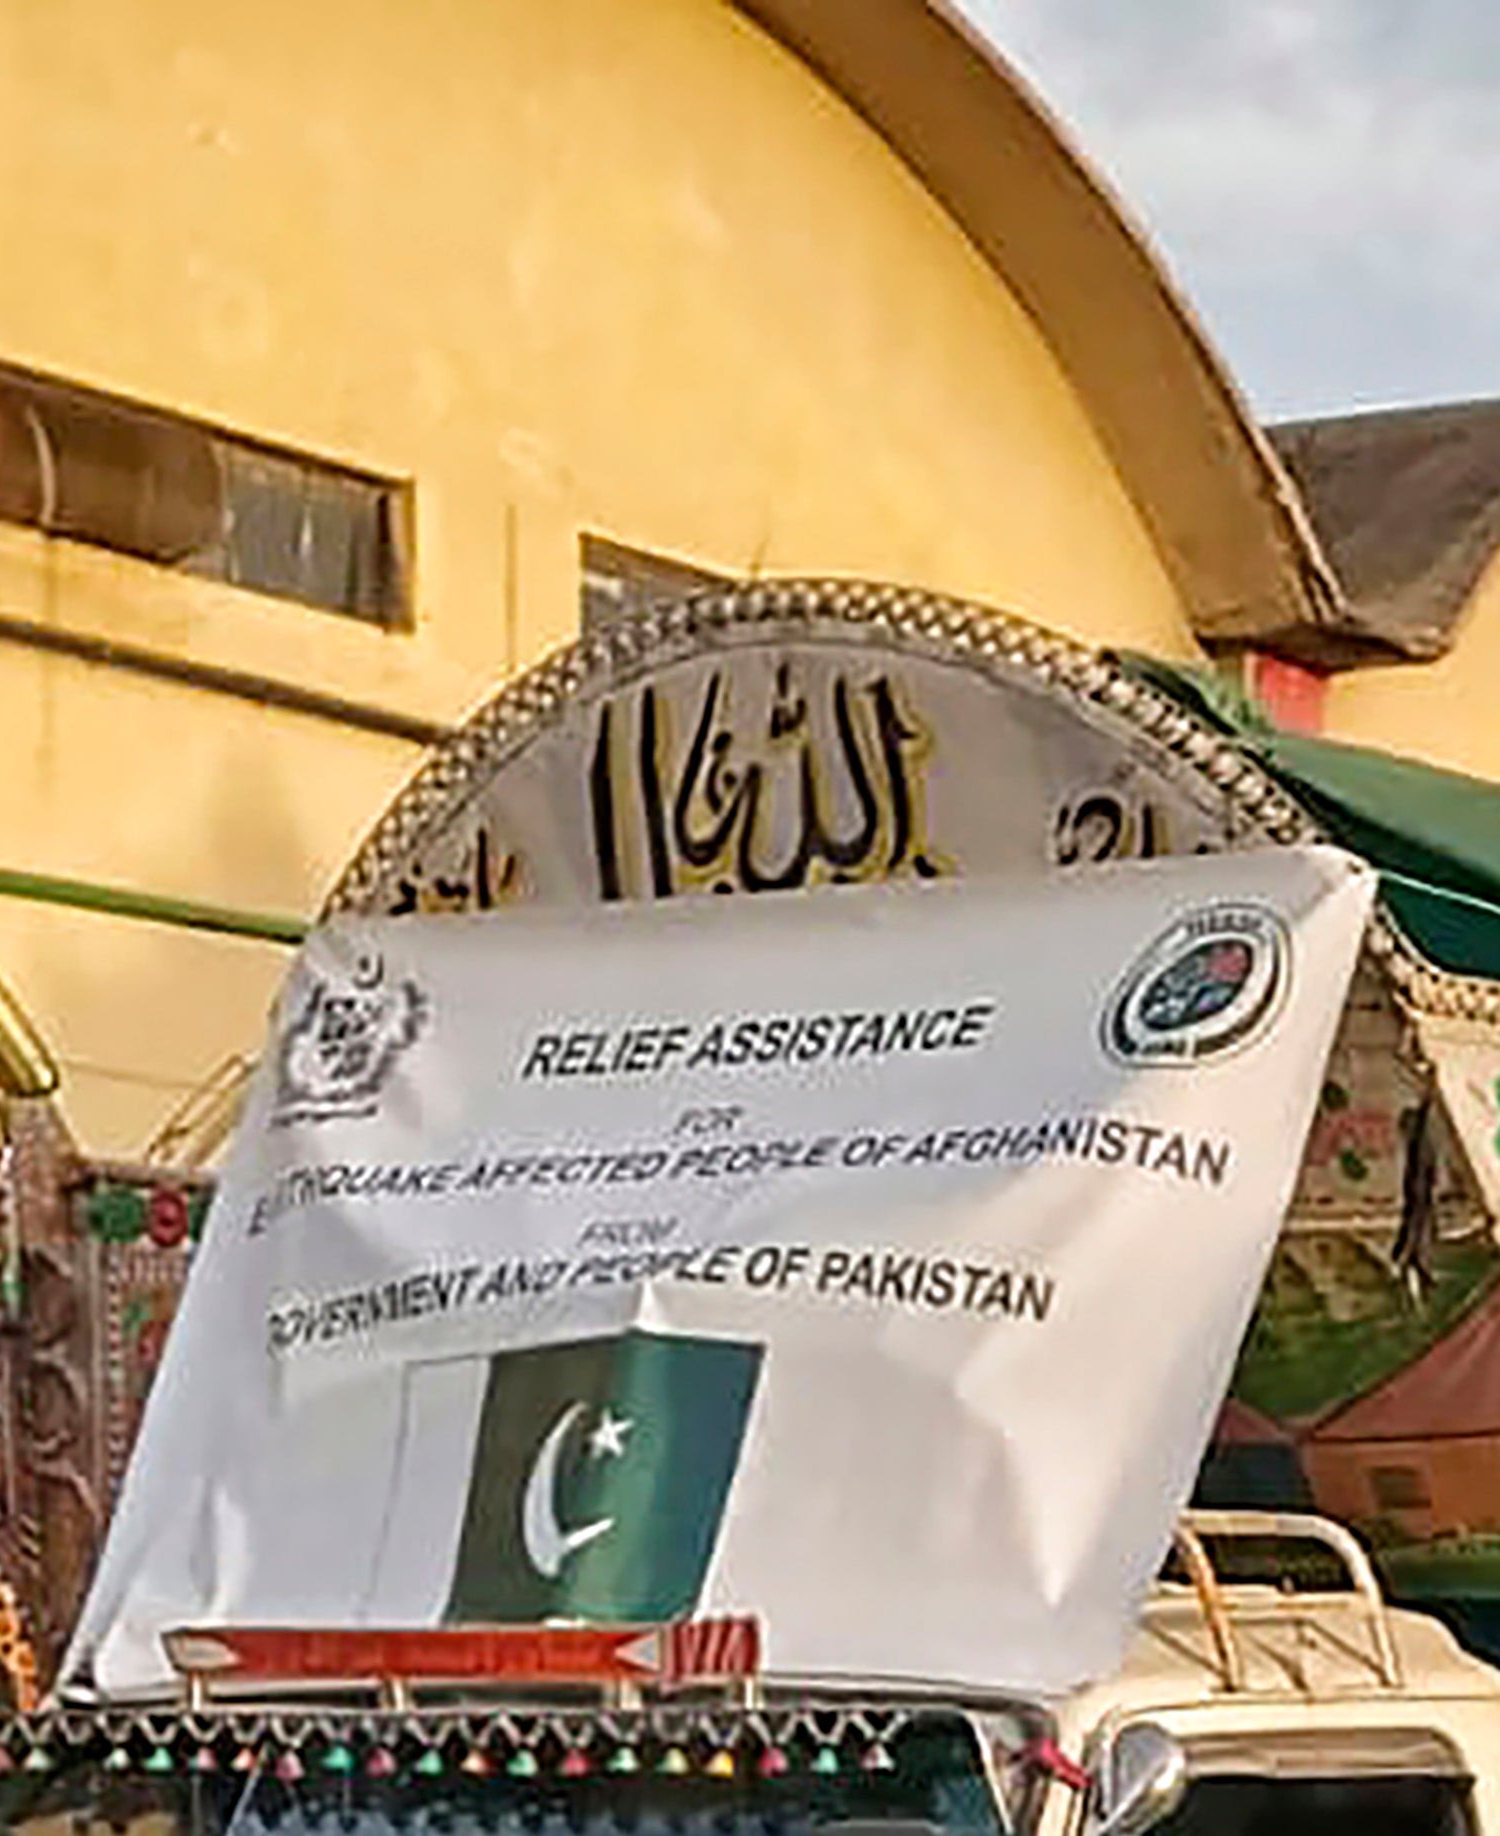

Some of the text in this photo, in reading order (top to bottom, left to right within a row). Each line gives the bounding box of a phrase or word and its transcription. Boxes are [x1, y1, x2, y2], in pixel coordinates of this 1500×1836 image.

[522, 1004, 996, 1080] RELIEF ASSISTANCE
[452, 1150, 664, 1190] AFFECTED
[668, 1136, 840, 1178] PEOPLE
[842, 1134, 910, 1169] OF
[902, 1116, 1232, 1186] AFGHANISTAN
[476, 1257, 570, 1302] AND
[570, 1246, 741, 1290] PEOPLE
[744, 1246, 812, 1291] OF
[814, 1249, 1056, 1323] PAKISTAN
